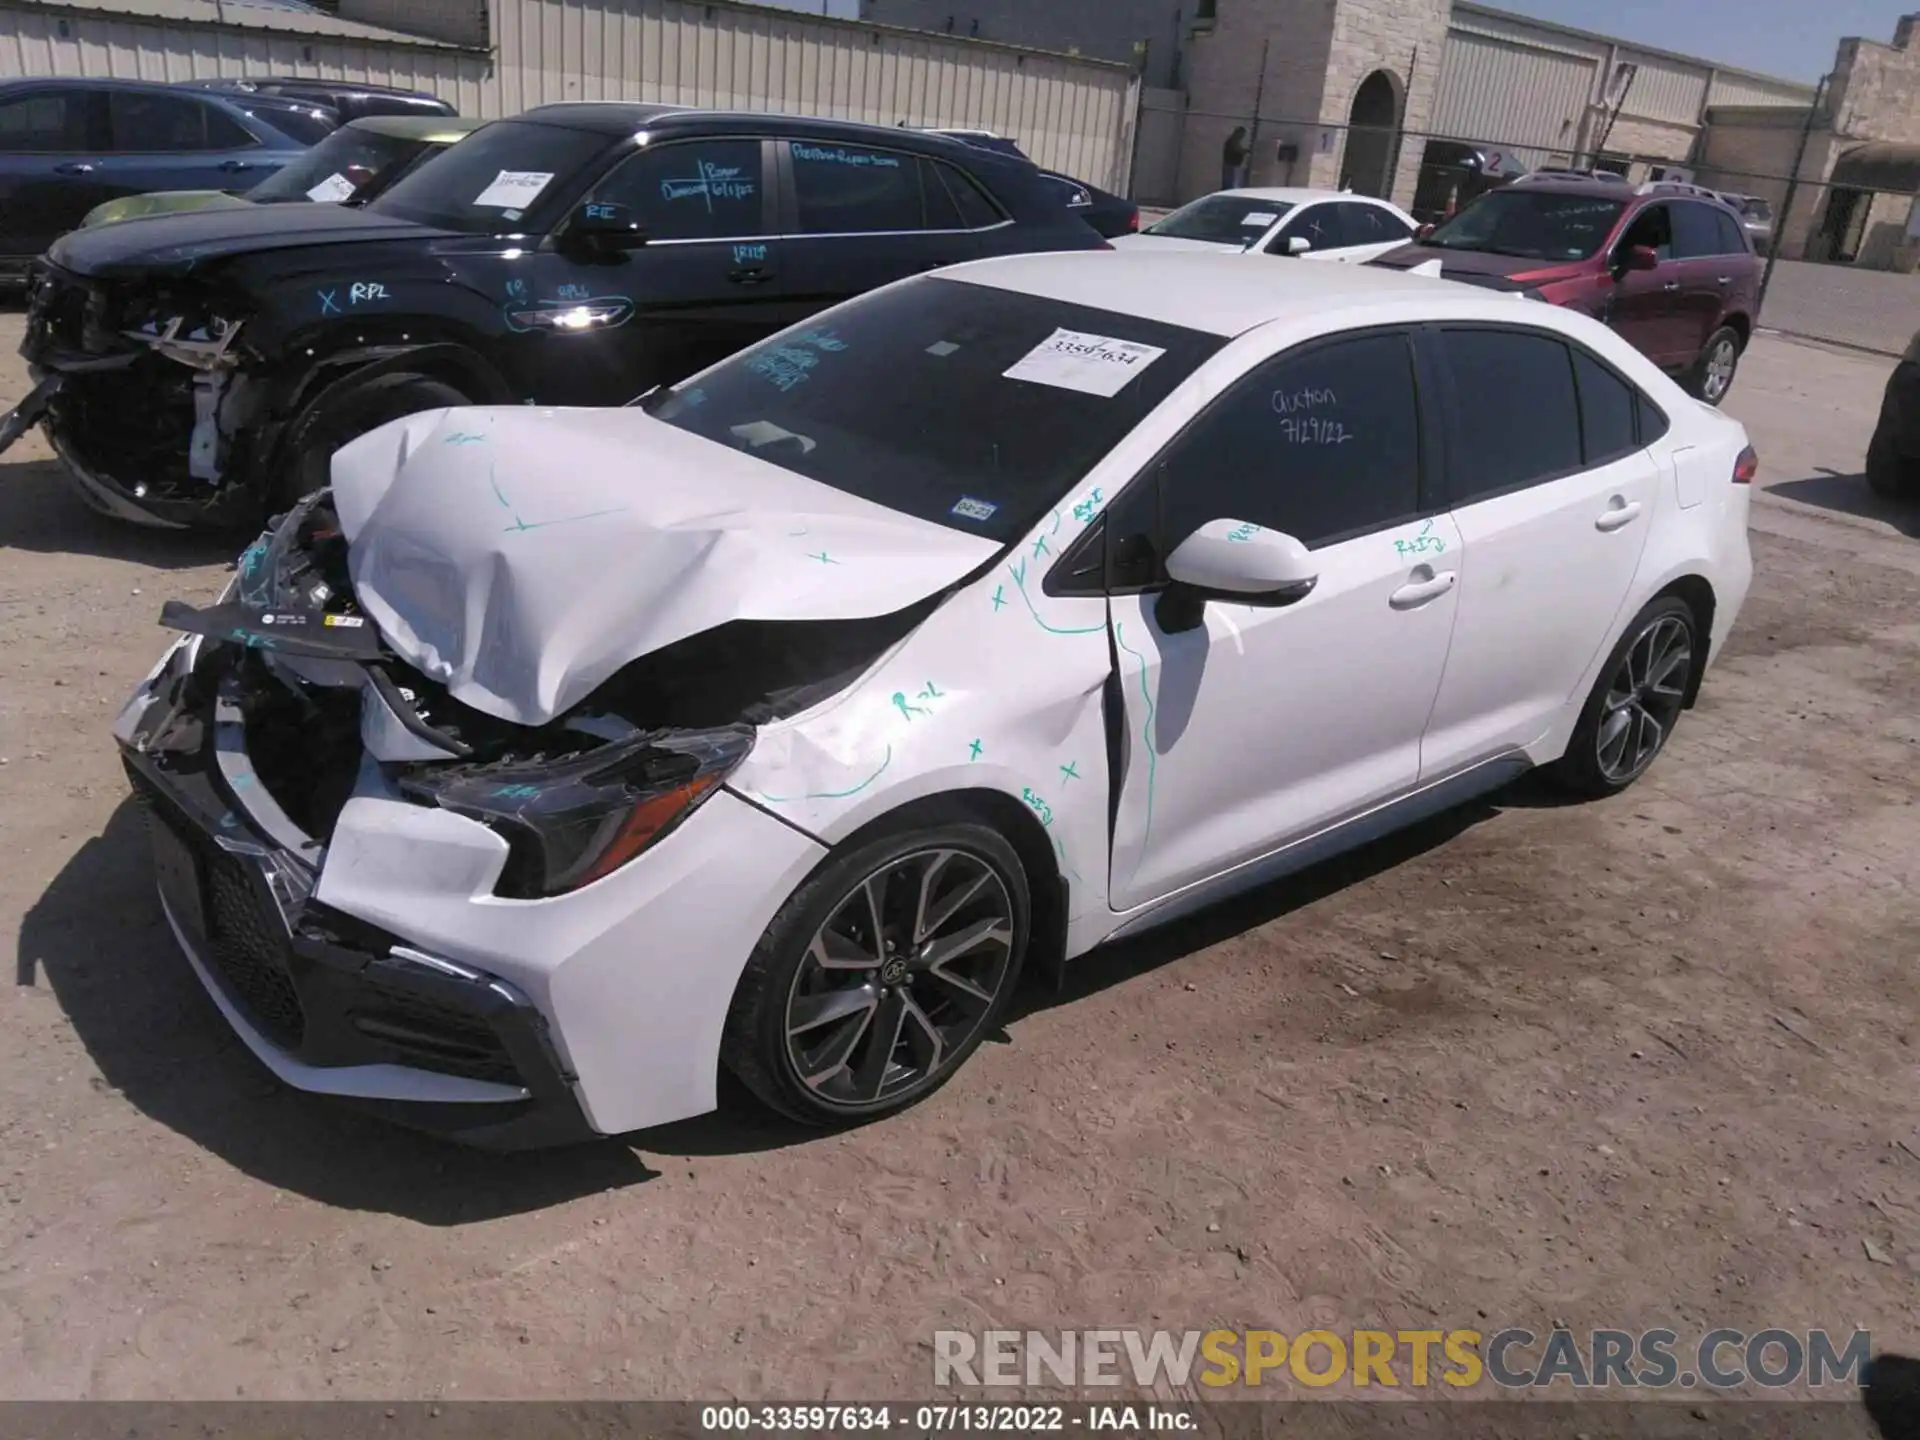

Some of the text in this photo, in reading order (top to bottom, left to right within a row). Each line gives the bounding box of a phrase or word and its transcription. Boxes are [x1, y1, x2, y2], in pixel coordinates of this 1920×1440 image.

[1488, 152, 1502, 172] 2
[1055, 340, 1139, 365] 33597634
[1280, 416, 1353, 444] 7/29/22
